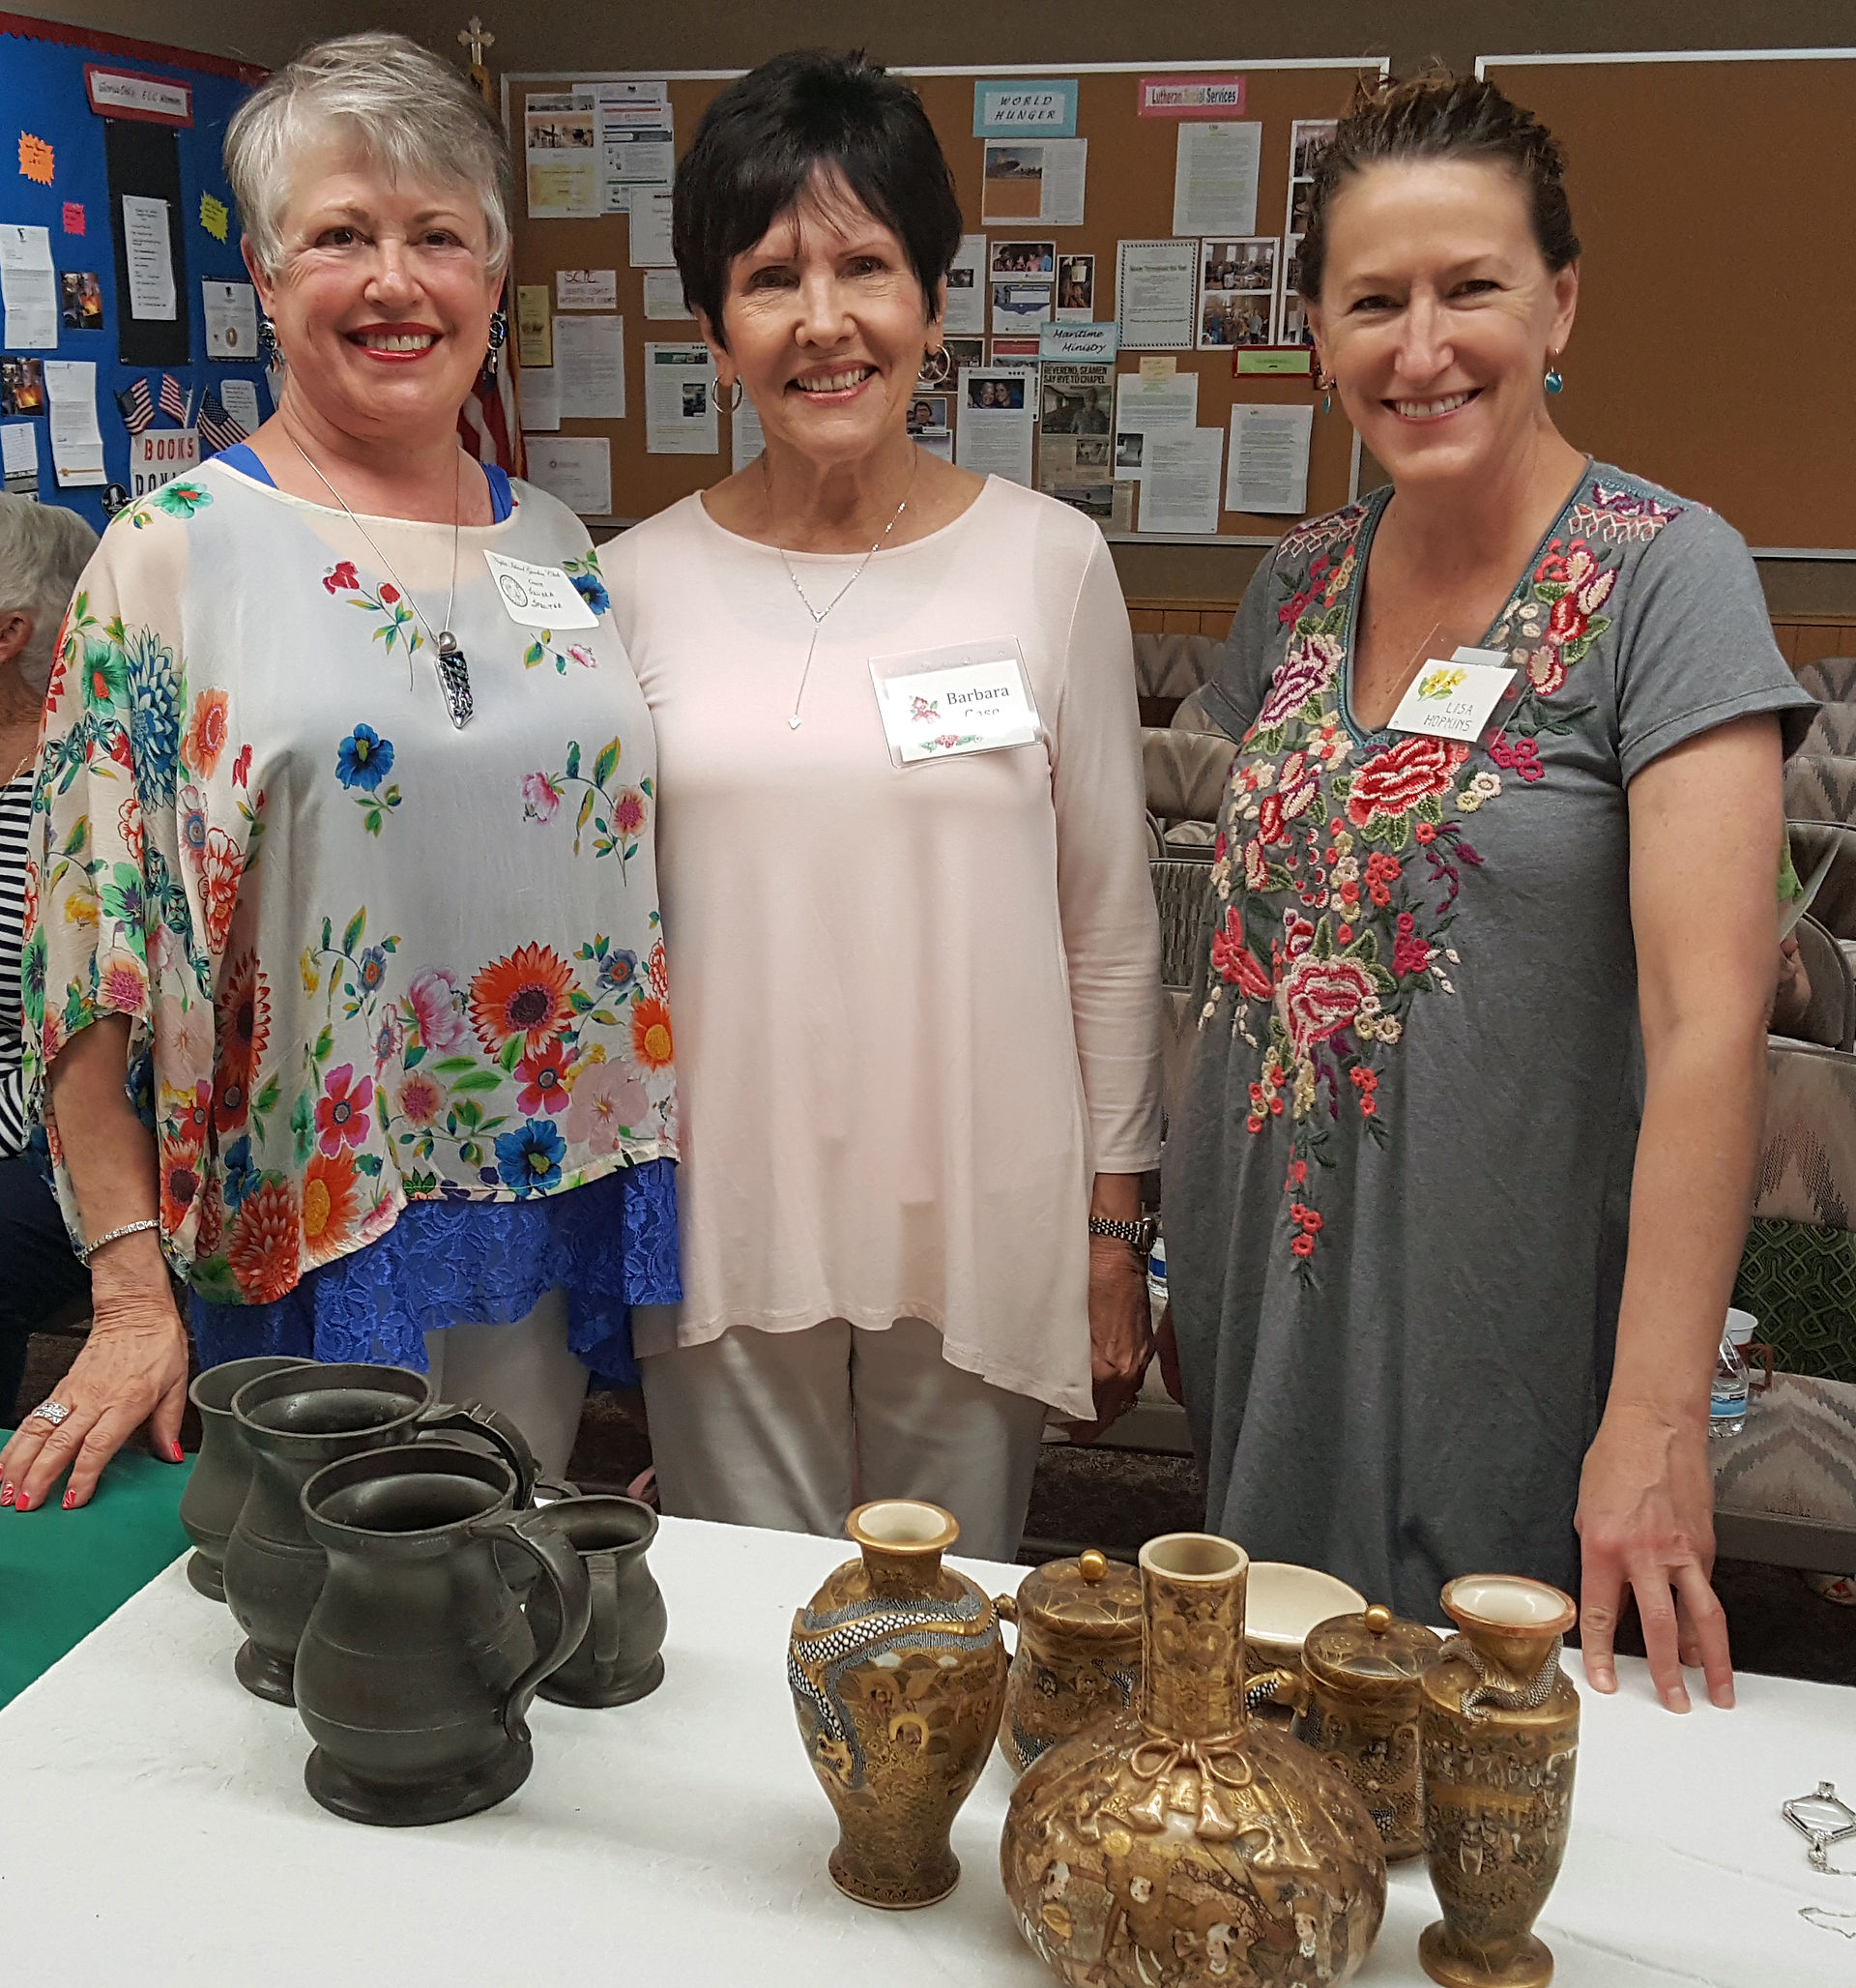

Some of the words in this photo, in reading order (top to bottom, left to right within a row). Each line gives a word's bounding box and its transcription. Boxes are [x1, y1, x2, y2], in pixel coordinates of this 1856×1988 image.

[1000, 96, 1053, 106] WORLD
[1151, 88, 1182, 104] Lutheran
[1205, 87, 1236, 103] Services
[994, 109, 1056, 121] HUNGER
[1053, 329, 1104, 338] Maritime
[1061, 341, 1107, 355] Ministry
[144, 437, 194, 461] BOOKS
[135, 470, 187, 496] DON
[946, 687, 1010, 706] Barbara
[1445, 702, 1474, 716] LISA
[1423, 714, 1473, 732] HOPKINS
